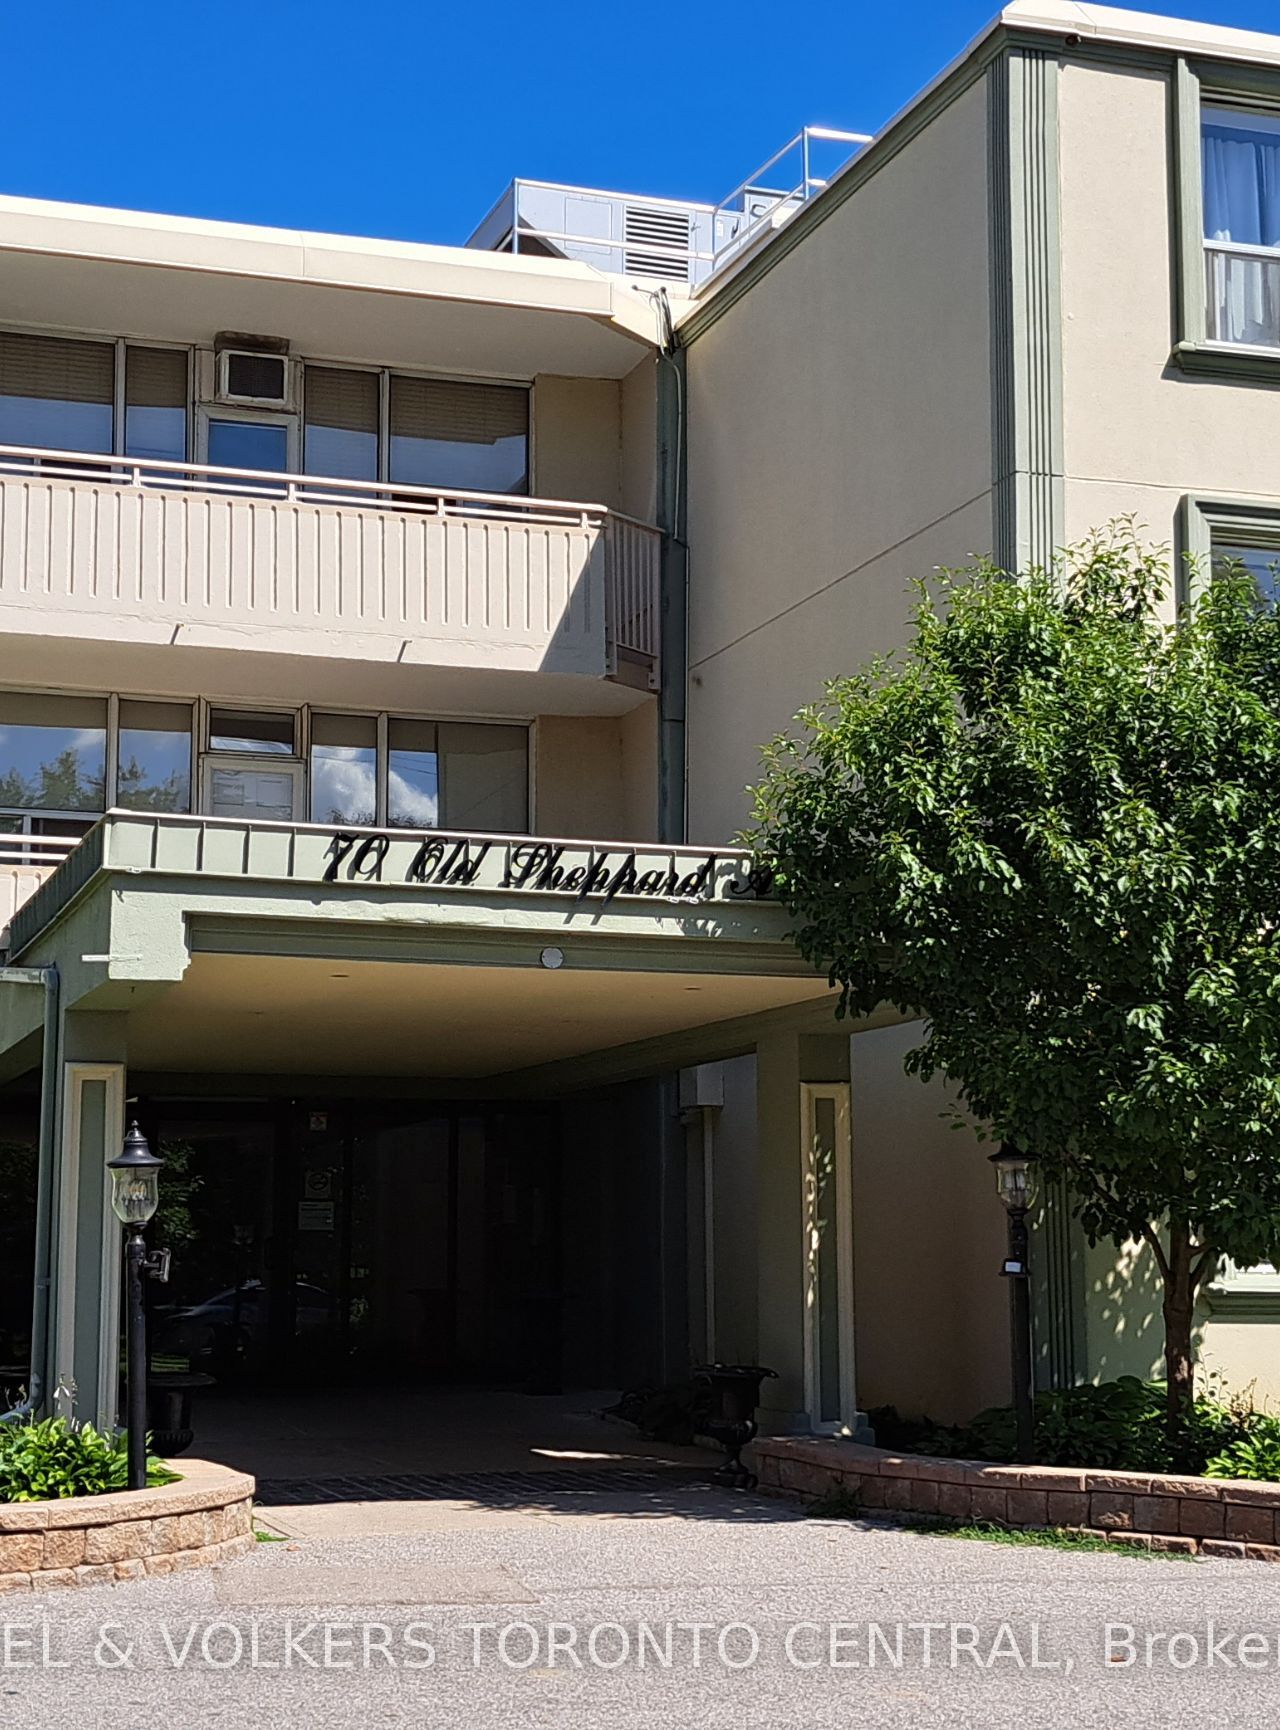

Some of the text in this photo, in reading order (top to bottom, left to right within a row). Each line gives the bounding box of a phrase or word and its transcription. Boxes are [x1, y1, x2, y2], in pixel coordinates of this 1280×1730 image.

[322, 832, 391, 881] 70
[411, 837, 492, 883] Old
[503, 842, 718, 907] Sheppard
